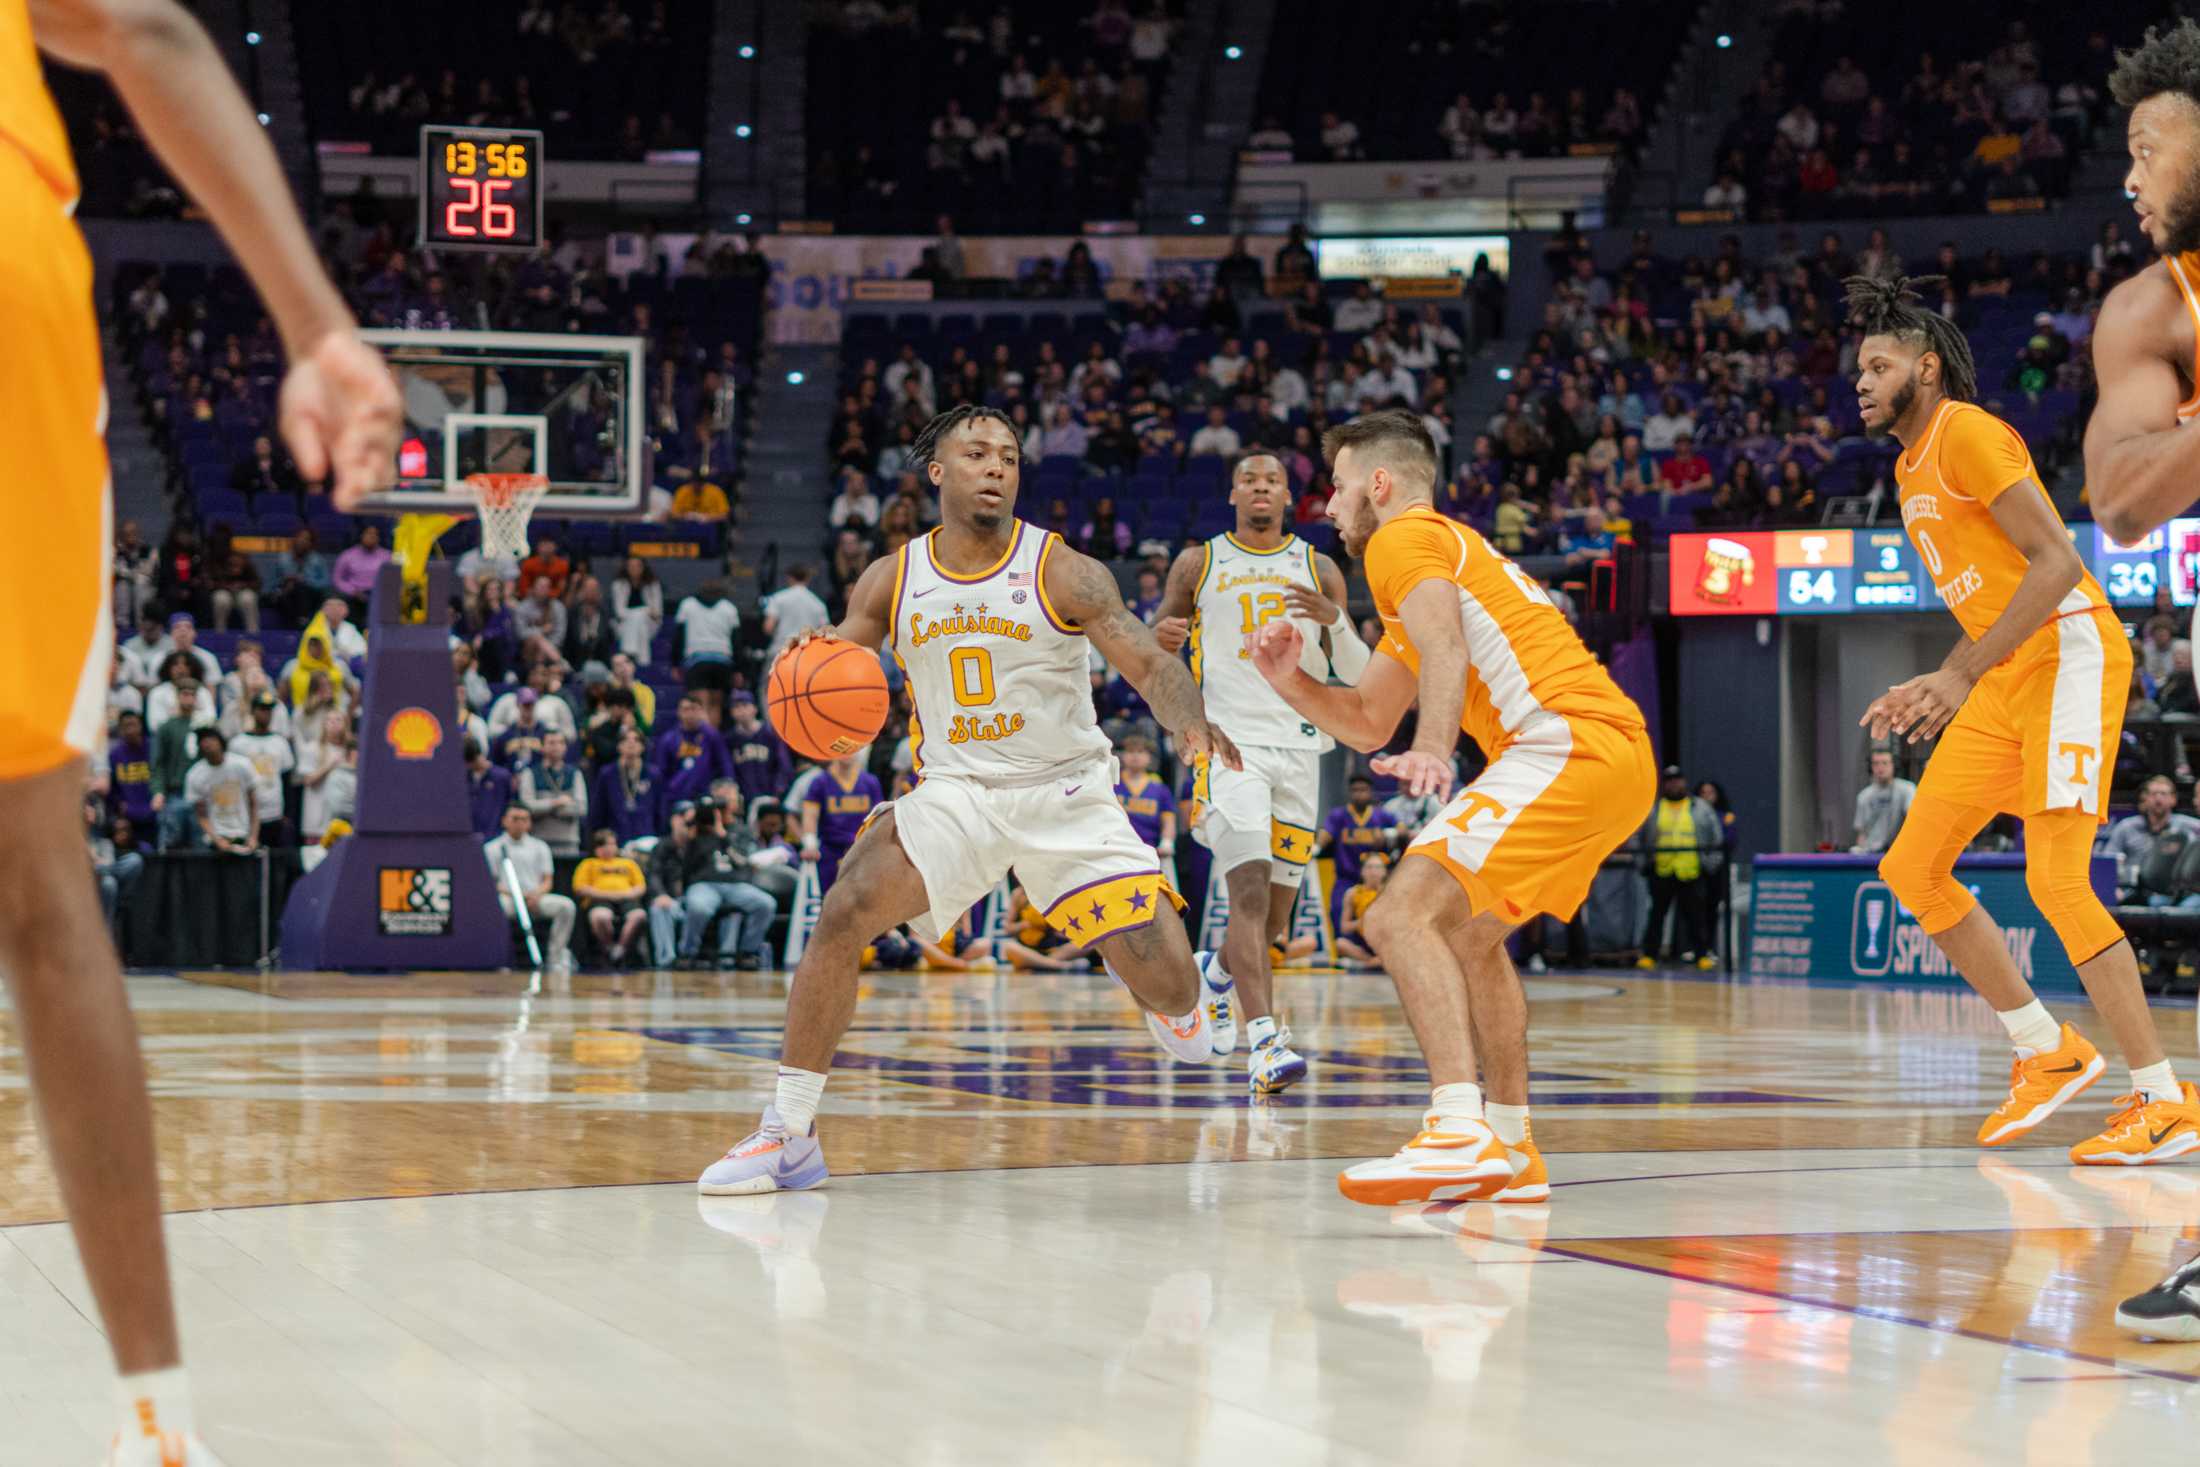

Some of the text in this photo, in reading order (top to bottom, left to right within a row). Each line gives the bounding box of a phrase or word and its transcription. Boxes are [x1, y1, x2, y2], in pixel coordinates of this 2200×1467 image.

[446, 142, 527, 178] 13:56
[446, 178, 515, 237] 26
[1879, 547, 1900, 570] 3
[1918, 530, 1943, 576] 0
[1788, 569, 1837, 605] 54
[2108, 562, 2158, 598] 30
[910, 612, 1033, 648] Louisiana
[1237, 592, 1288, 634] 12
[948, 646, 997, 707] 0
[948, 712, 1026, 745] State
[2058, 742, 2096, 785] T
